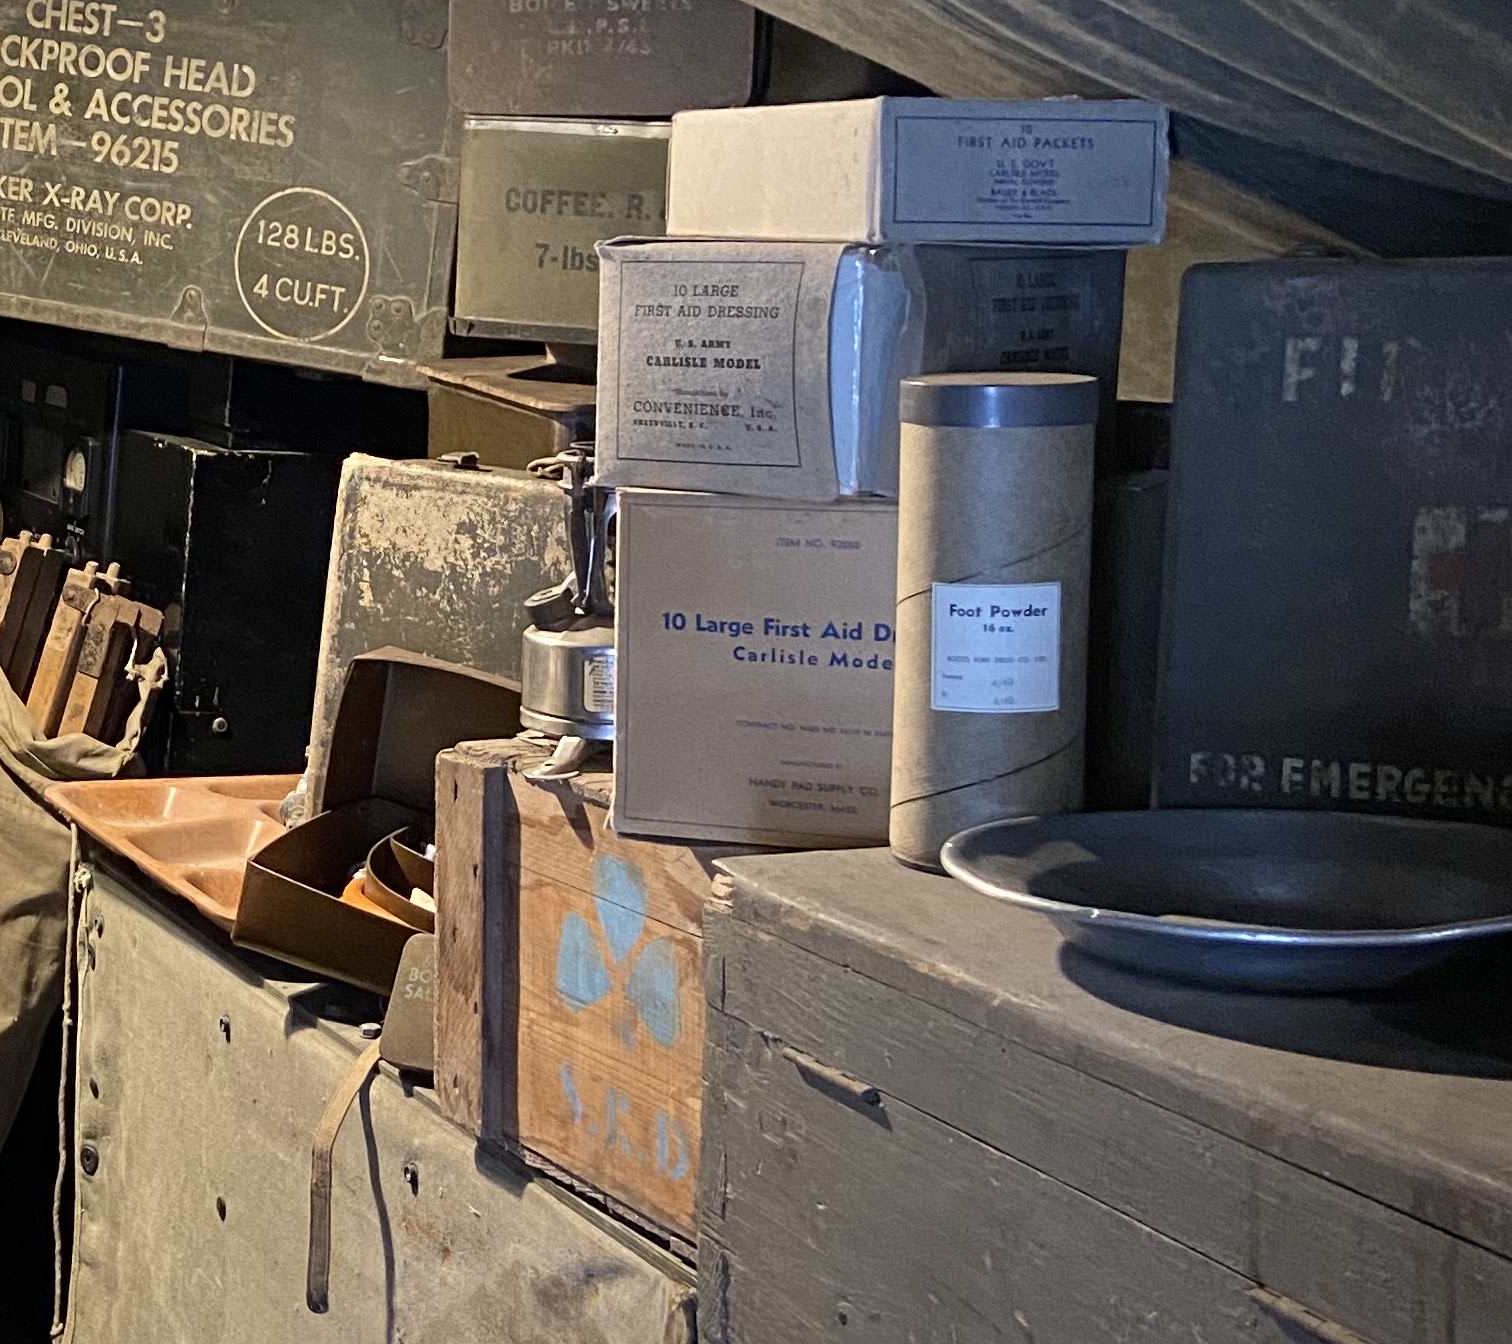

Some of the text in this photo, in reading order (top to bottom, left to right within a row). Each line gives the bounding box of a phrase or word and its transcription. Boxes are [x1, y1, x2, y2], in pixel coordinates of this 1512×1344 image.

[163, 55, 256, 98] HEAD
[49, 82, 73, 117] &
[84, 88, 296, 148] ACCESSORIES
[957, 135, 1094, 149] FIRST AID PACKETS
[42, 181, 121, 217] X-RAY
[124, 196, 193, 229] CORP.
[21, 210, 58, 231] MFG.
[66, 217, 136, 246] DIVISION,
[143, 230, 174, 250] INC.
[258, 219, 359, 261] 128 LBS.
[65, 239, 101, 260] OHIO,
[253, 274, 269, 298] 4
[673, 285, 739, 297] 10 LARGE
[634, 305, 780, 319] FIRST AID DRESSING
[701, 340, 731, 349] ARMY
[646, 356, 761, 370] CARLISLE MODEL
[949, 604, 1048, 617] Foot Powder
[662, 612, 686, 630] 10
[695, 614, 754, 637] Large
[763, 618, 810, 638] First
[820, 622, 863, 640] Aid
[983, 624, 995, 632] 16
[733, 646, 894, 670] Carlisle Mode
[1190, 751, 1266, 793] FOR
